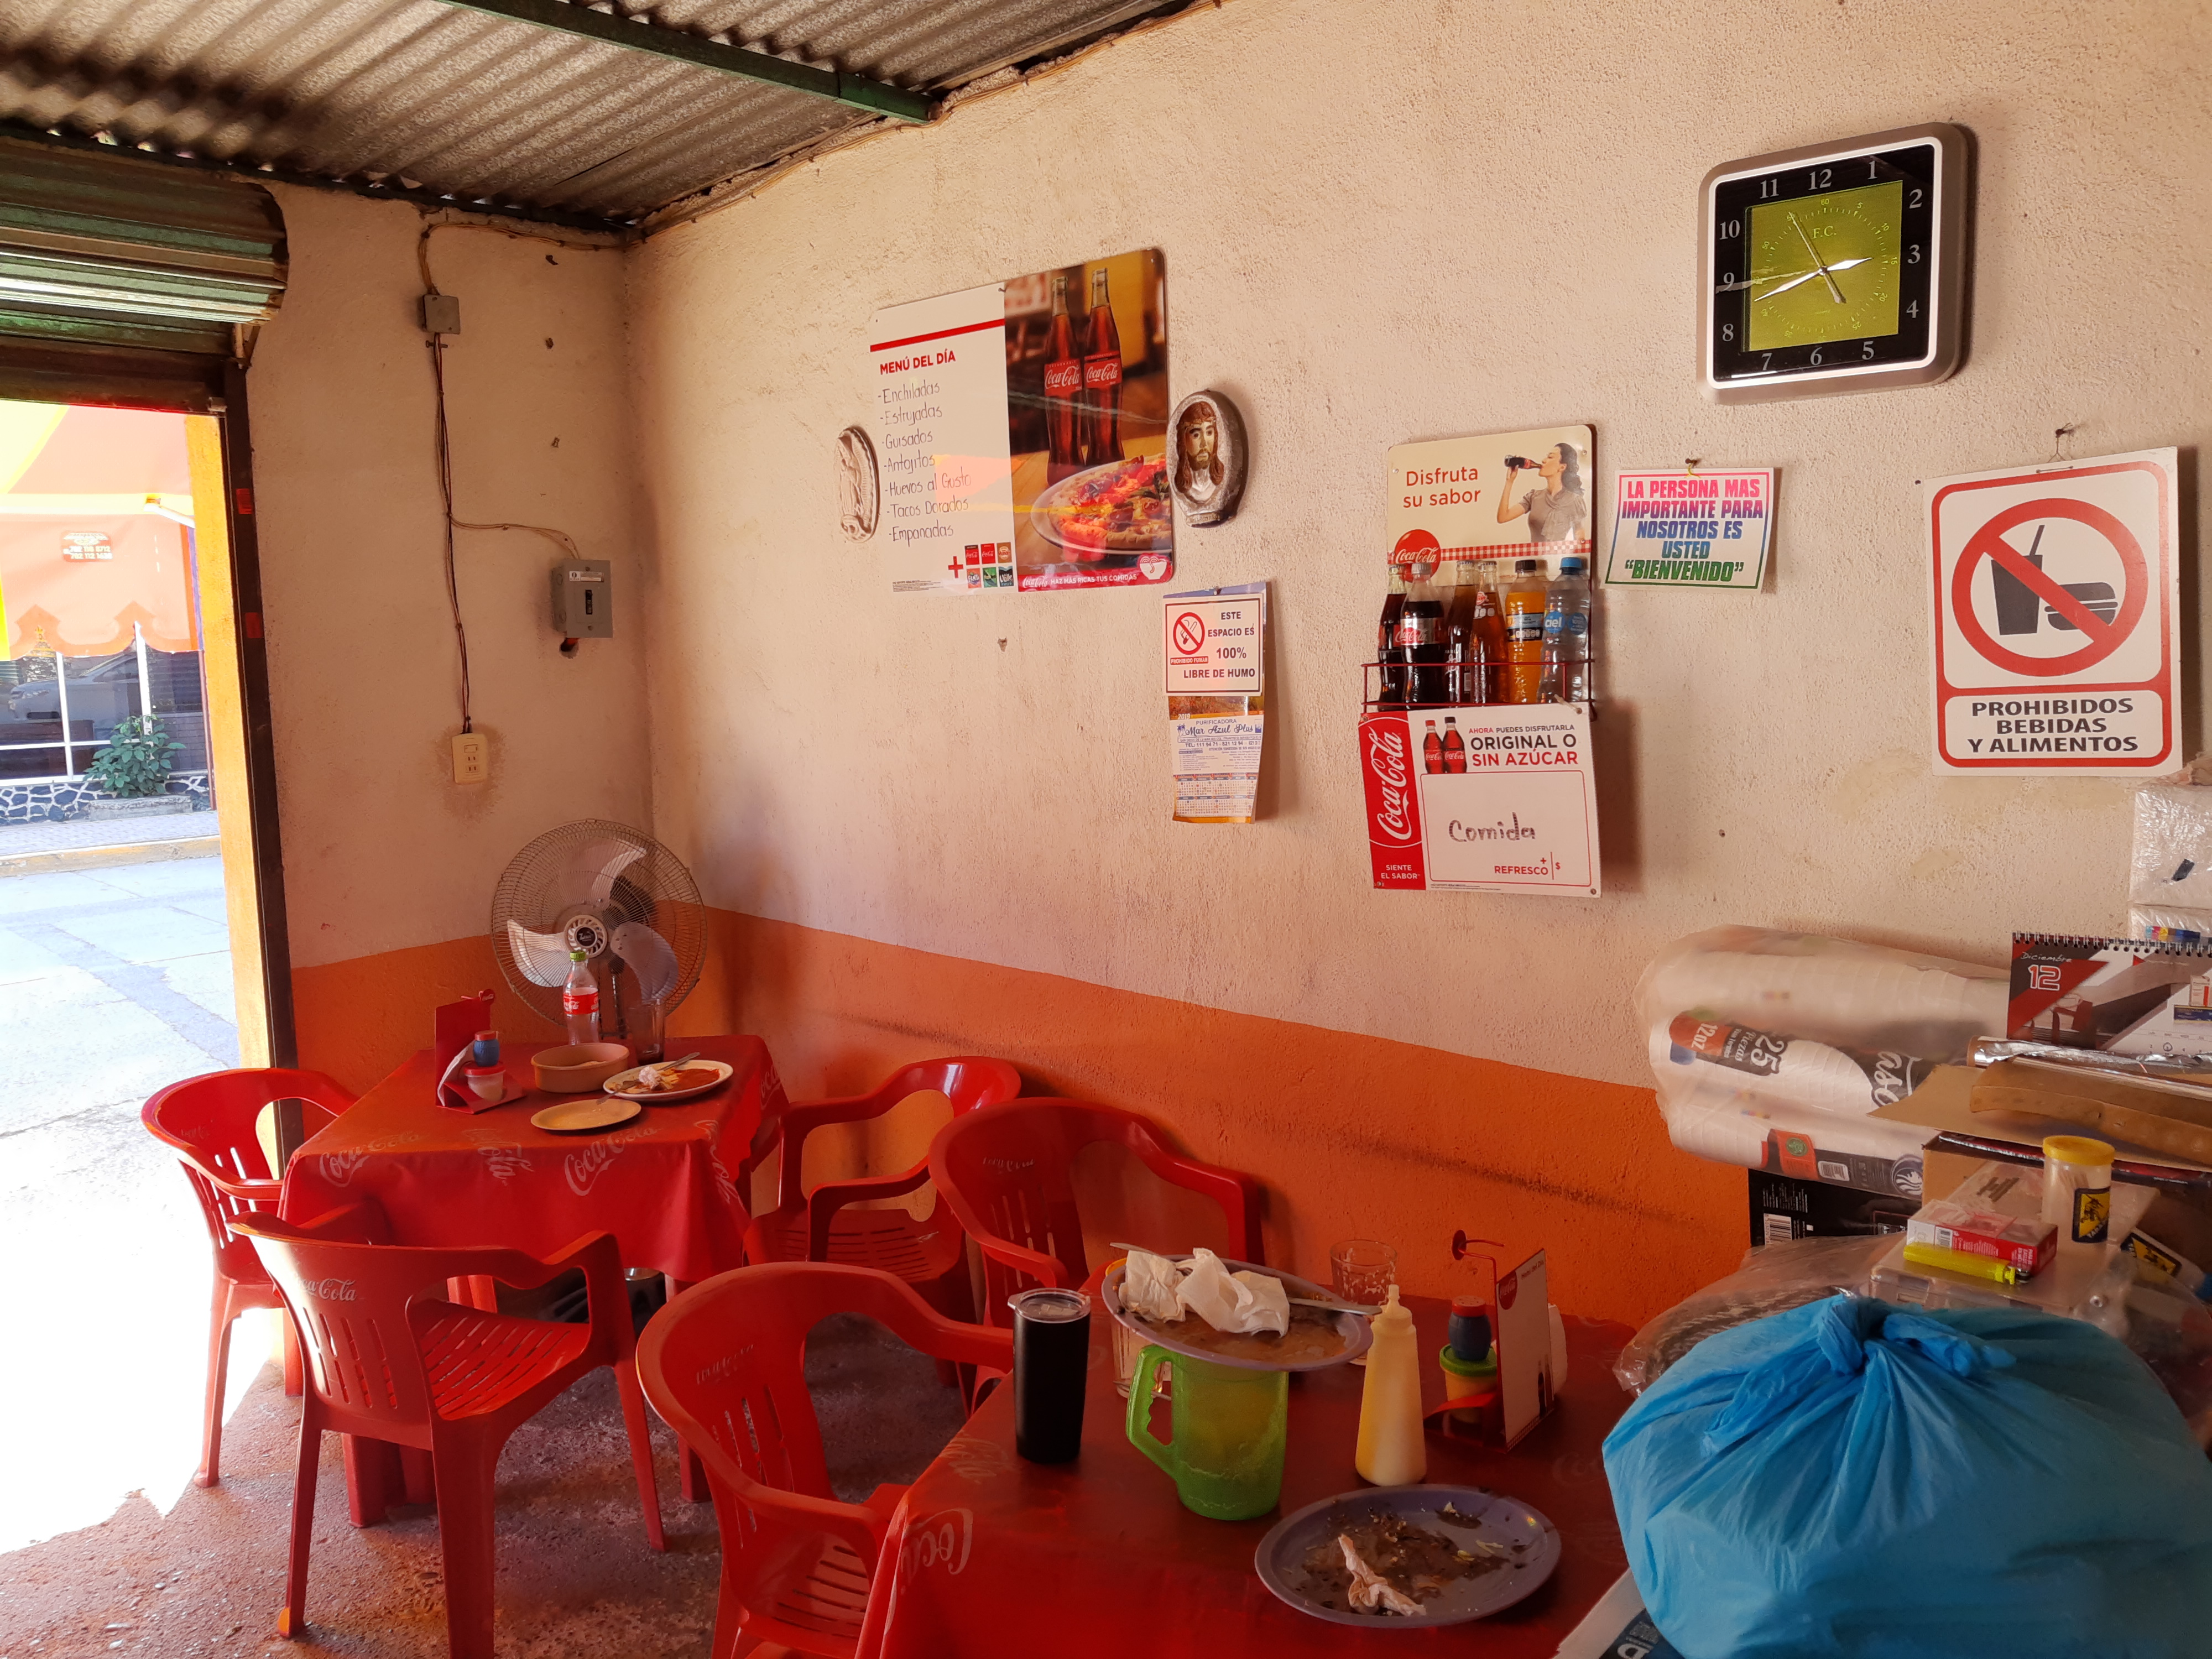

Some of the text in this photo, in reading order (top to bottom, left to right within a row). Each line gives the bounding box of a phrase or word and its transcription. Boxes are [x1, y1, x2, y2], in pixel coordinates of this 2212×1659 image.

[1867, 160, 1877, 180] 1
[1760, 179, 1779, 199] 11
[1808, 169, 1832, 191] 12
[1908, 189, 1923, 209] 2
[1719, 220, 1740, 240] 10
[1812, 226, 1837, 239] F.C.
[1908, 244, 1920, 264] 3
[1723, 272, 1735, 291] 9
[1906, 300, 1919, 319] 4
[1722, 324, 1734, 342] 8
[1810, 347, 1822, 366] 6
[1861, 341, 1874, 361] 5
[880, 349, 956, 375] MENÚ DEL DÍA
[1762, 353, 1772, 371] 7
[1045, 365, 1079, 389] Coca-Cola
[1086, 363, 1118, 383] Coca-Cola
[927, 473, 937, 492] al
[941, 467, 971, 489] Gusto
[1406, 466, 1478, 487] Disfruta
[1627, 479, 1760, 498] LA PERSONA MAS
[925, 498, 969, 515] Dorados
[1403, 489, 1481, 508] su sabor
[1621, 499, 1763, 519] IMPORTANTE PARA
[1636, 520, 1743, 539] NOSOTROS ES
[1395, 546, 1439, 564] Coca-Cola
[1661, 541, 1710, 559] USTED
[1022, 576, 1049, 588] Coca-Cola
[1221, 611, 1241, 620] ESTE
[1208, 627, 1254, 637] ESPACIO ES
[1395, 628, 1428, 643] Coca-Cola
[1216, 646, 1246, 659] 100%
[1183, 668, 1255, 679] LIBRE DE HUMO
[1972, 698, 2133, 717] PROHIBIDOS
[1185, 723, 1254, 737] Mar Azul Plus
[1525, 724, 1575, 733] DISFRUTARLA
[1997, 718, 2107, 734] BEBIDAS
[1470, 733, 1577, 751] ORIGINAL O
[1968, 736, 2138, 753] Y ALIMENTOS
[1445, 751, 1464, 760] Coca-Cola
[1472, 748, 1578, 766] SIN AZÚCAR
[1368, 726, 1412, 840] Coca-Cola
[1449, 812, 1536, 842] Comida
[1494, 865, 1548, 875] REFRESCO
[1555, 862, 1561, 870] $
[2021, 951, 2072, 963] Diciembre
[2028, 964, 2061, 991] 12
[1734, 1031, 1756, 1062] Piezas
[1750, 1035, 1785, 1071] 25
[319, 1131, 419, 1188] Coca-Cola
[564, 1127, 663, 1197] Coca-Cola
[298, 1278, 357, 1302] ca-Cola
